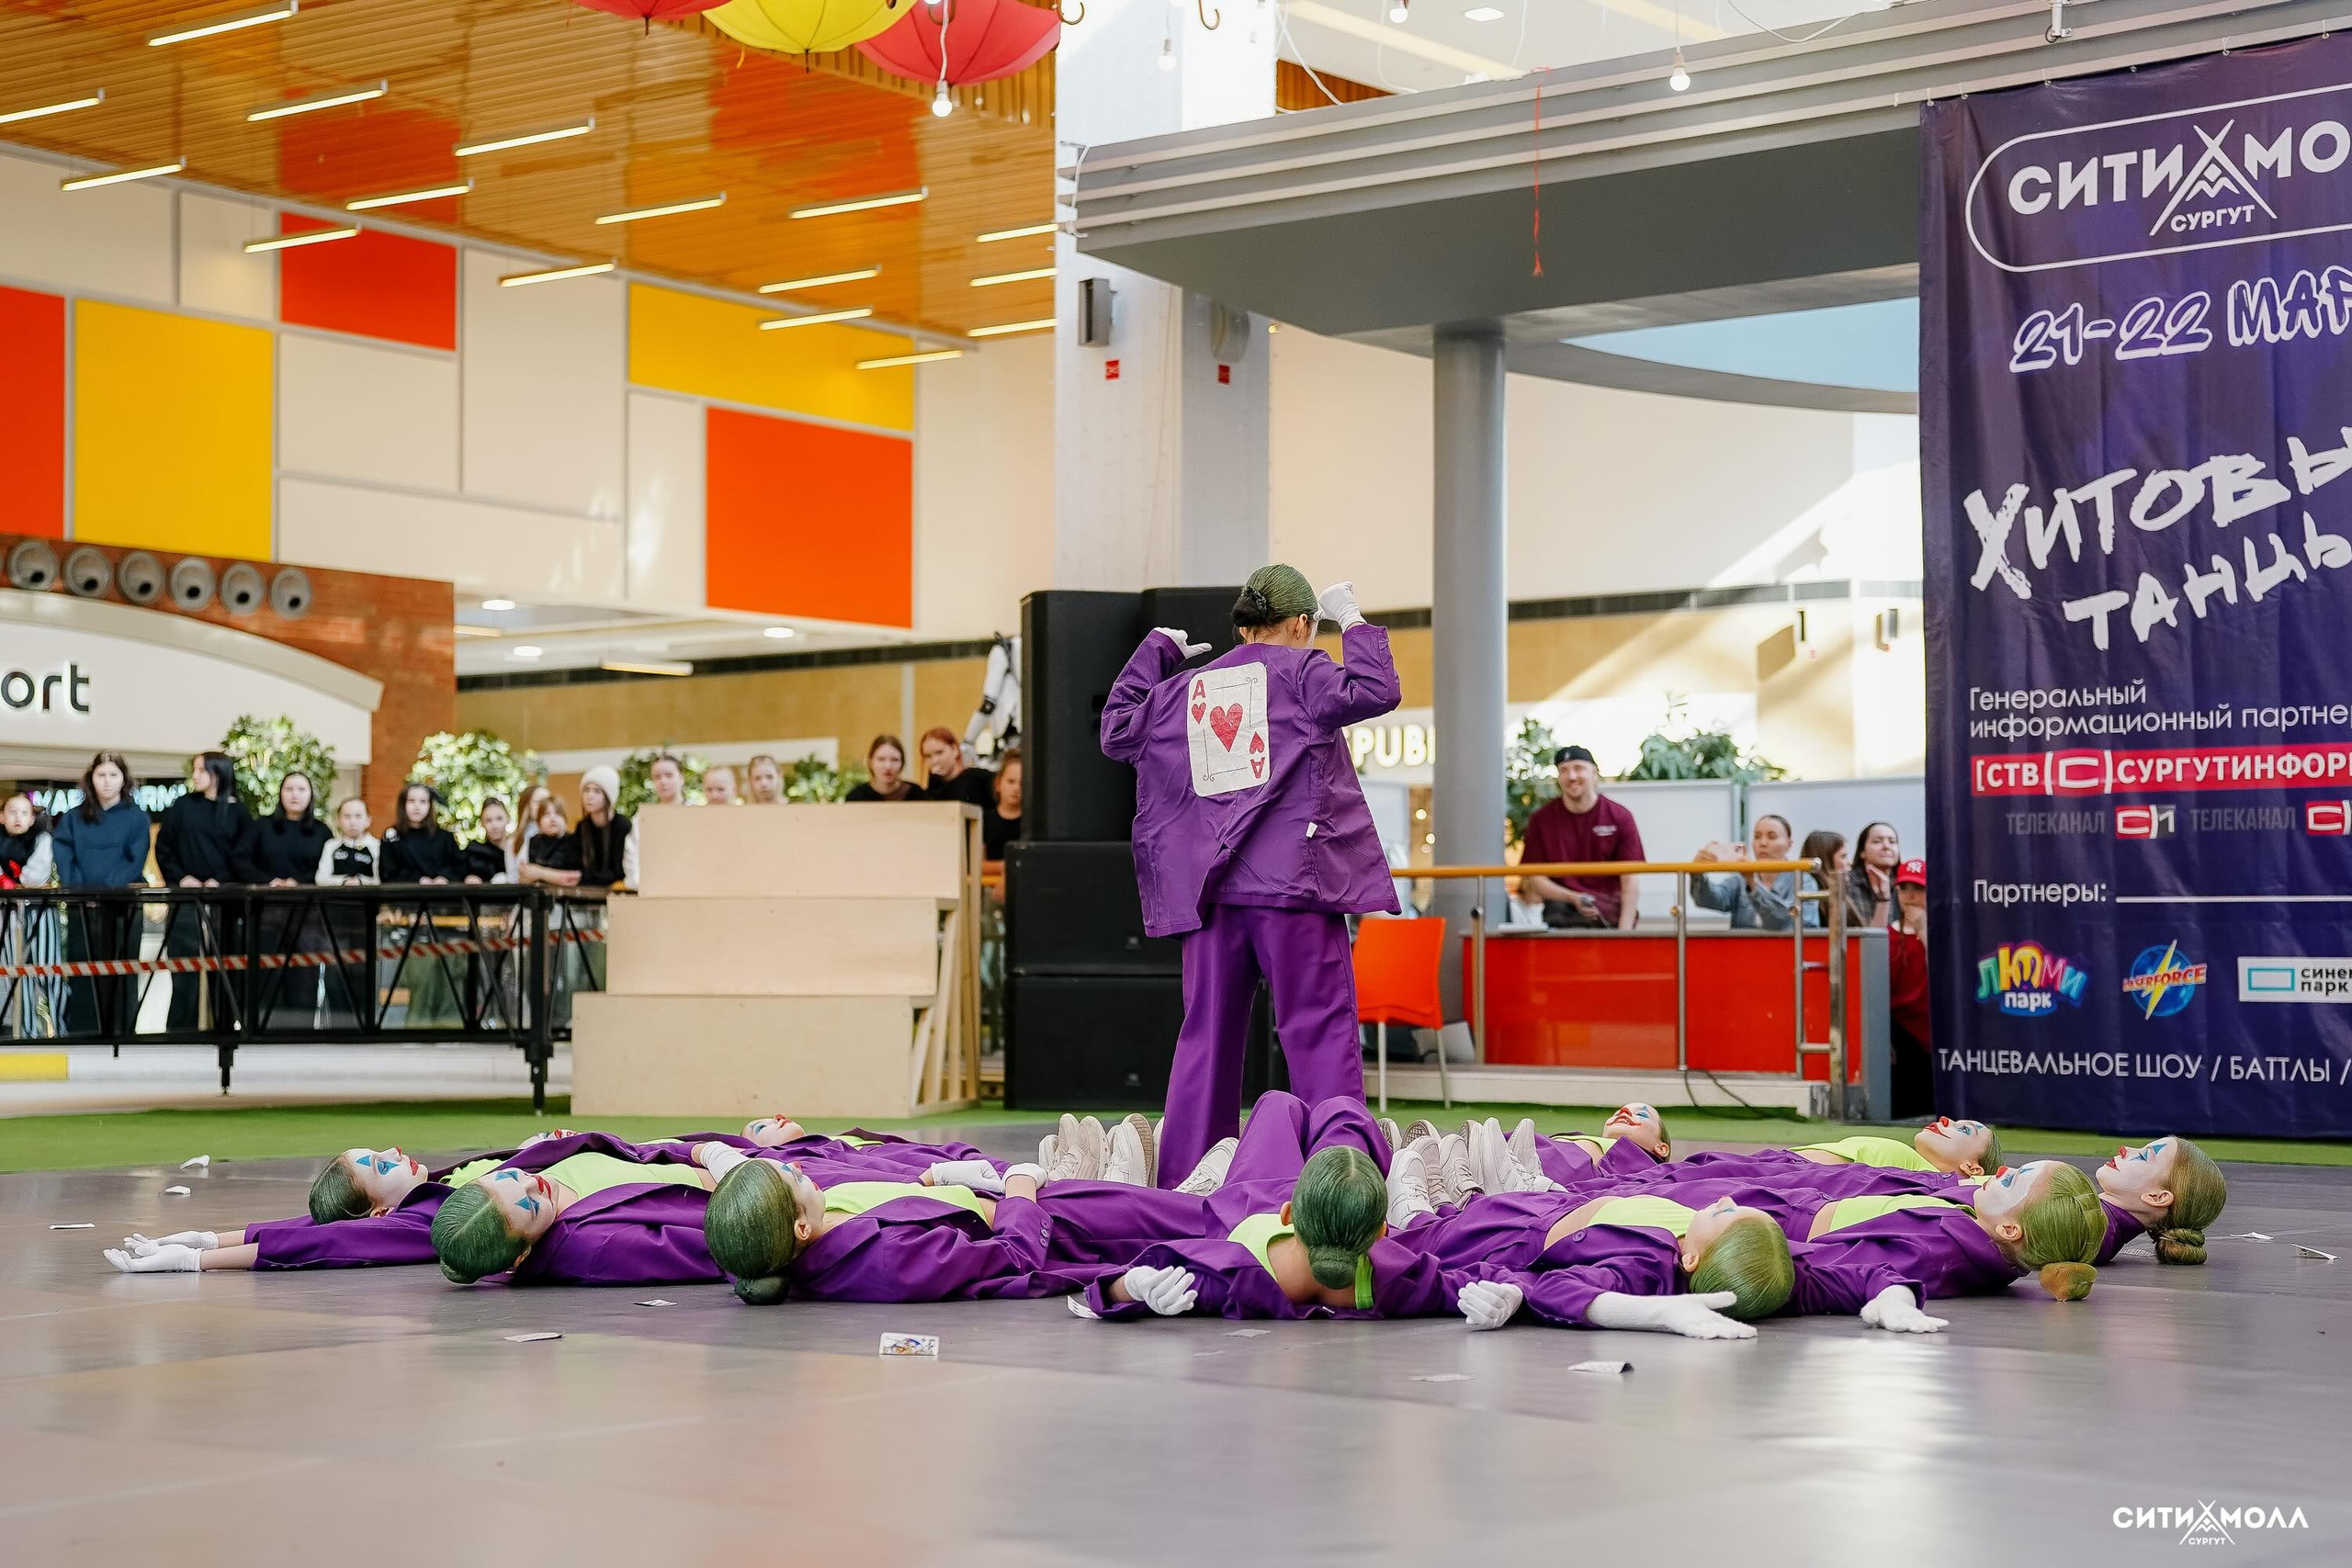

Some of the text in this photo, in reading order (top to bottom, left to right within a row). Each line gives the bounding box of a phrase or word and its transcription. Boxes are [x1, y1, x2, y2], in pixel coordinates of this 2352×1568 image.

[2007, 143, 2184, 215] СИТИ
[2170, 204, 2256, 232] СУРГУТ
[2009, 291, 2212, 373] 21-22
[1192, 679, 1206, 701] A
[1970, 678, 2147, 714] Генеральный
[1970, 703, 2352, 742] информационный партне
[1250, 757, 1265, 779] A
[2006, 810, 2106, 835] ТЕЛЕКАНАЛ
[2189, 807, 2296, 831] ТЕЛЕКАНАЛ
[1973, 878, 2107, 908] Партнеры:
[1977, 944, 2087, 999] ЛЮМИ
[2301, 967, 2352, 980] сине
[2004, 991, 2052, 1012] парк
[2301, 980, 2349, 997] парк
[1938, 1048, 2129, 1076] ТАНЦЕВАЛЬНОЕ
[2135, 1054, 2202, 1079] ШОУ
[2230, 1055, 2330, 1082] БАТТЛЫ
